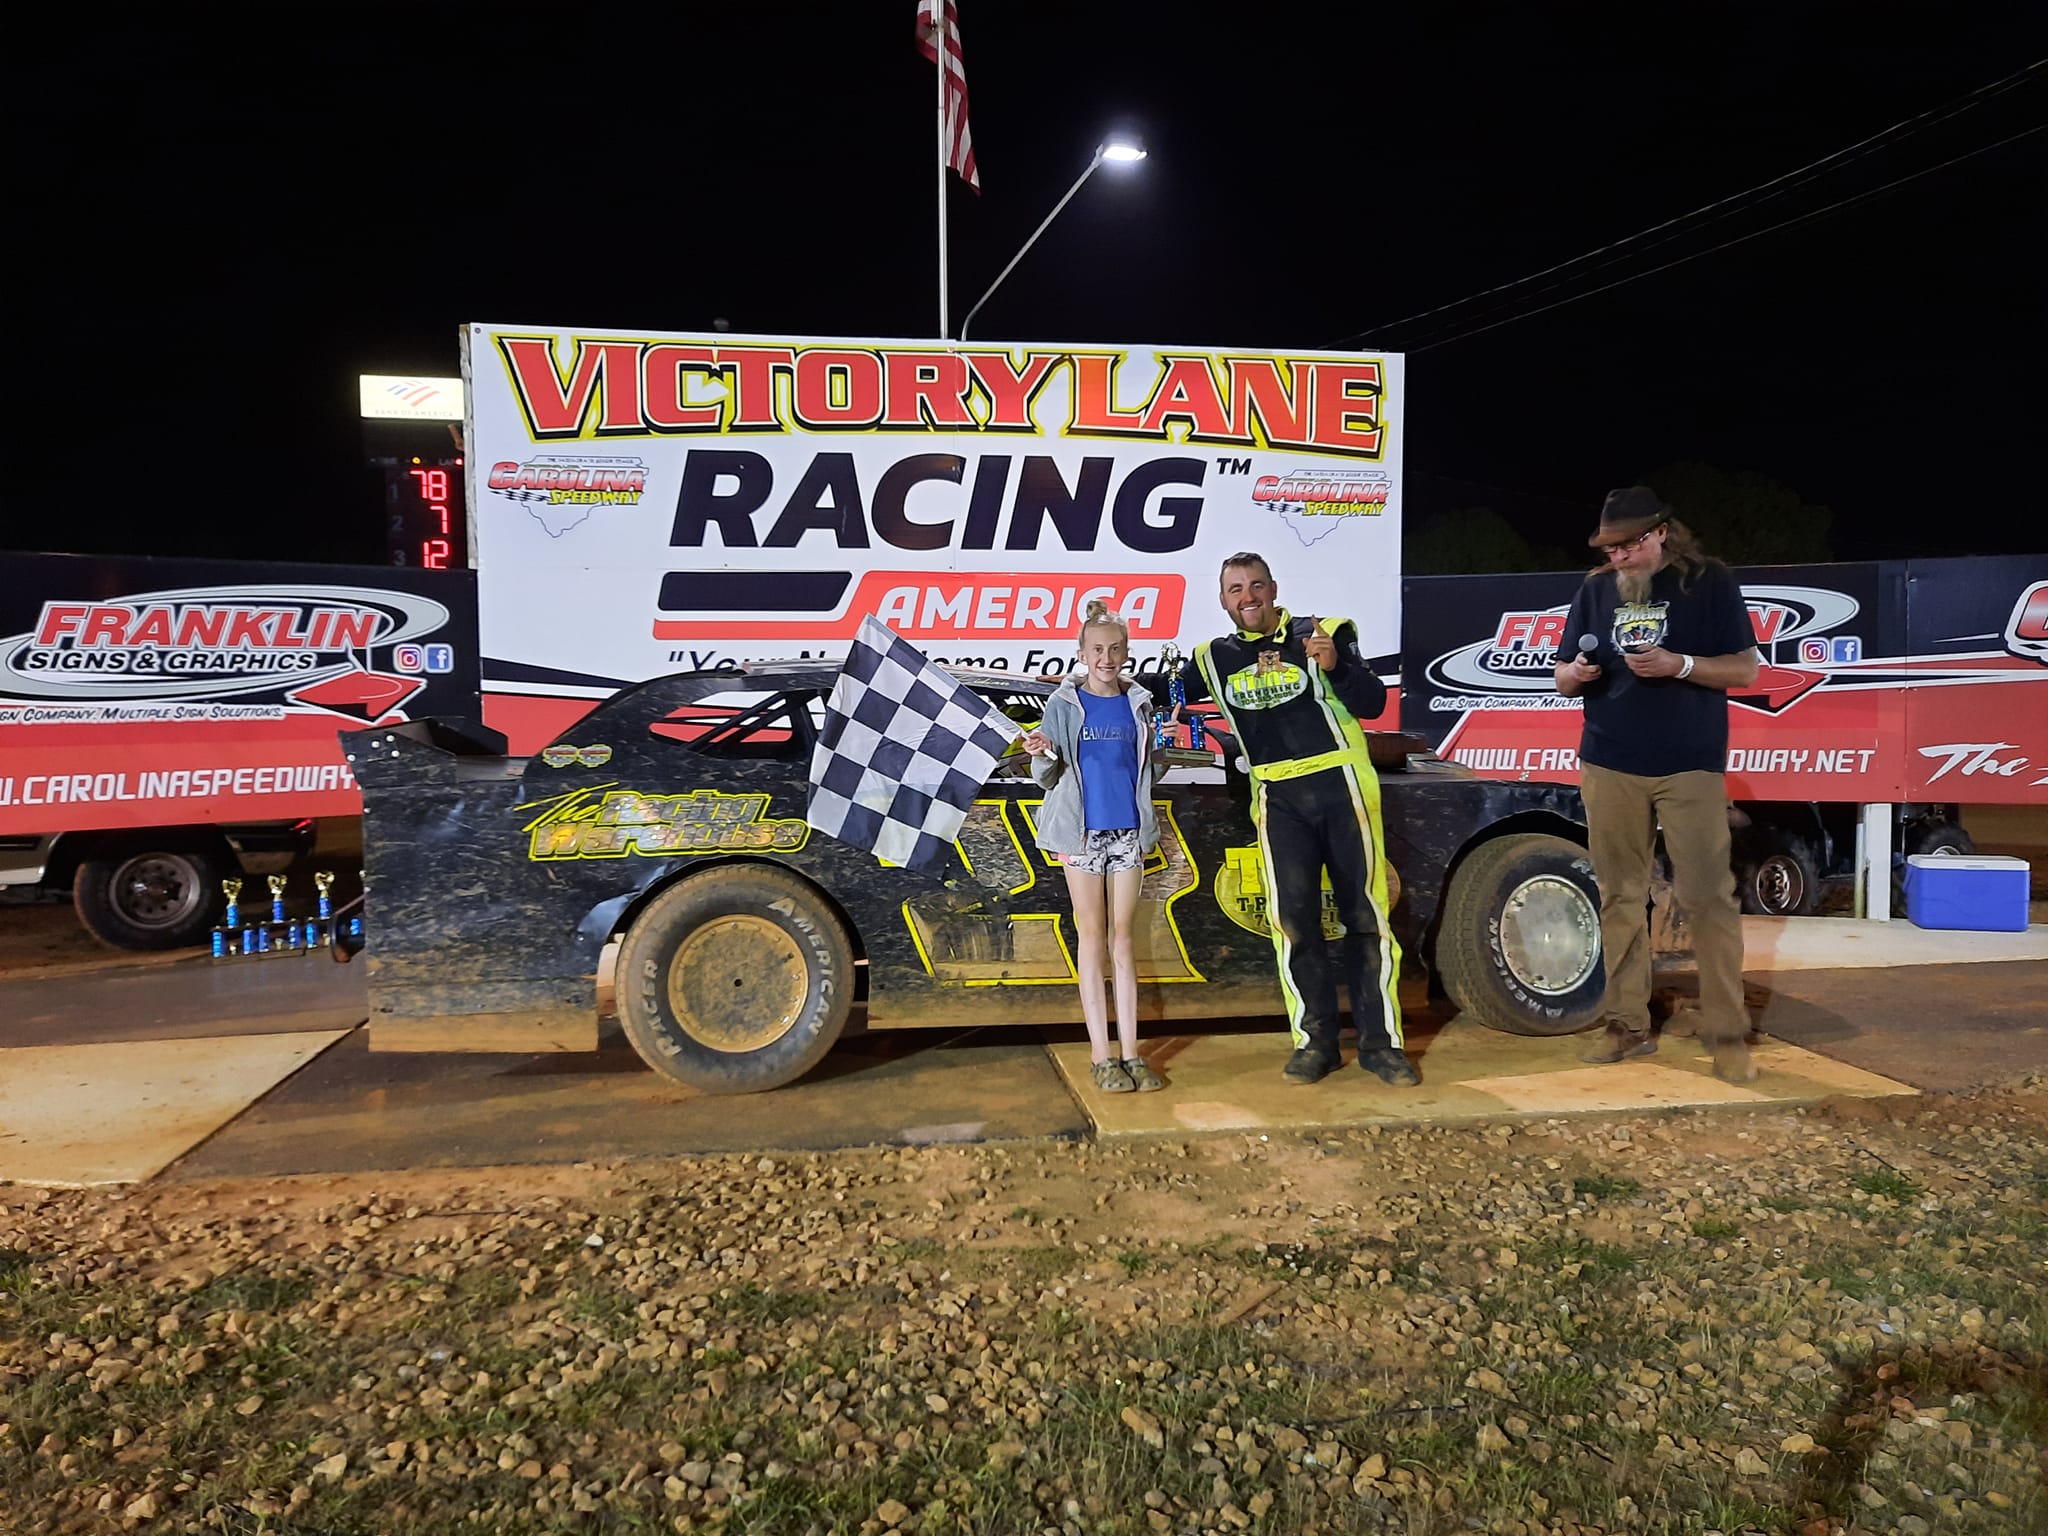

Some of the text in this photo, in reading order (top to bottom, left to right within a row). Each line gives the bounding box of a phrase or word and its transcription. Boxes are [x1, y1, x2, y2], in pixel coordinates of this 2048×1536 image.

[494, 334, 1388, 462] VICTORY LANE
[410, 470, 448, 500] 78
[488, 461, 645, 490] CAROLINA
[1252, 475, 1388, 503] CAROLINA
[547, 489, 643, 506] SPEEDWAY
[669, 448, 1207, 553] RACING
[1302, 501, 1388, 517] SPEEDWAY
[430, 505, 448, 534] 7
[423, 540, 449, 569] 12
[875, 586, 1161, 630] AMERICA
[36, 606, 378, 650] FRANKLIN
[29, 652, 314, 670] SIGNS & GRAPHICS
[101, 708, 170, 720] MULTIPLE
[173, 706, 207, 719] SIGN
[1432, 698, 1454, 709] ONE
[1457, 698, 1482, 709] SIGN
[1541, 698, 1584, 709] MULTIP
[1918, 742, 2031, 786] The
[514, 782, 771, 832] The Racing
[530, 819, 812, 861] Warehouse
[767, 897, 835, 1037] AMERICAN
